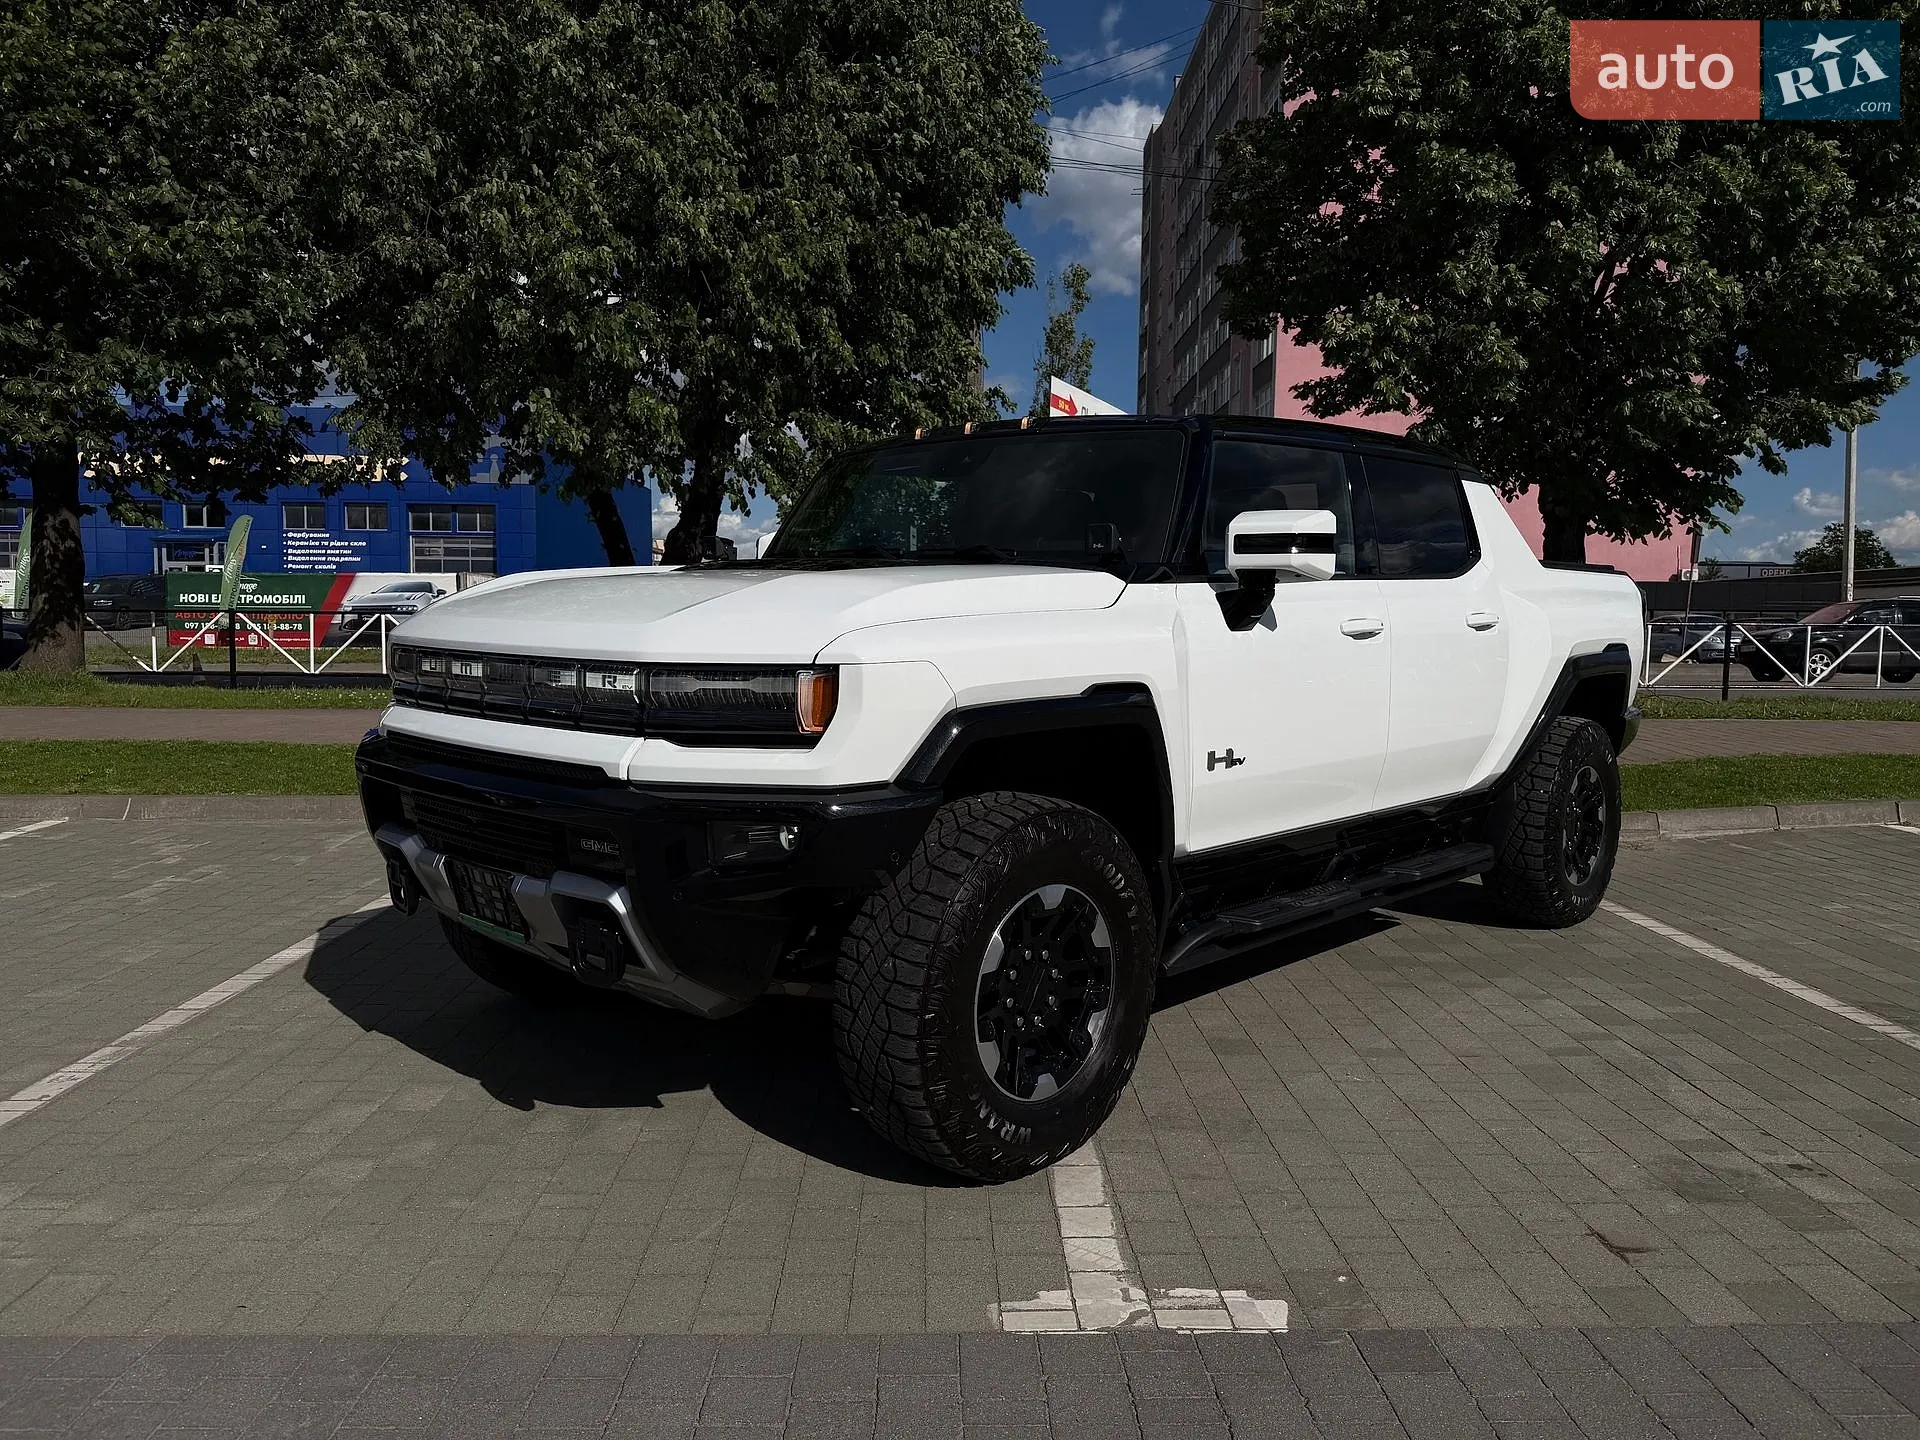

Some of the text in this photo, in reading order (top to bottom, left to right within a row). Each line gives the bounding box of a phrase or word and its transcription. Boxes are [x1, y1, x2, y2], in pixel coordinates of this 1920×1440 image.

[180, 593, 306, 604] НОВІ ЕЛТРОМОБІЛІ
[581, 838, 620, 856] GMC
